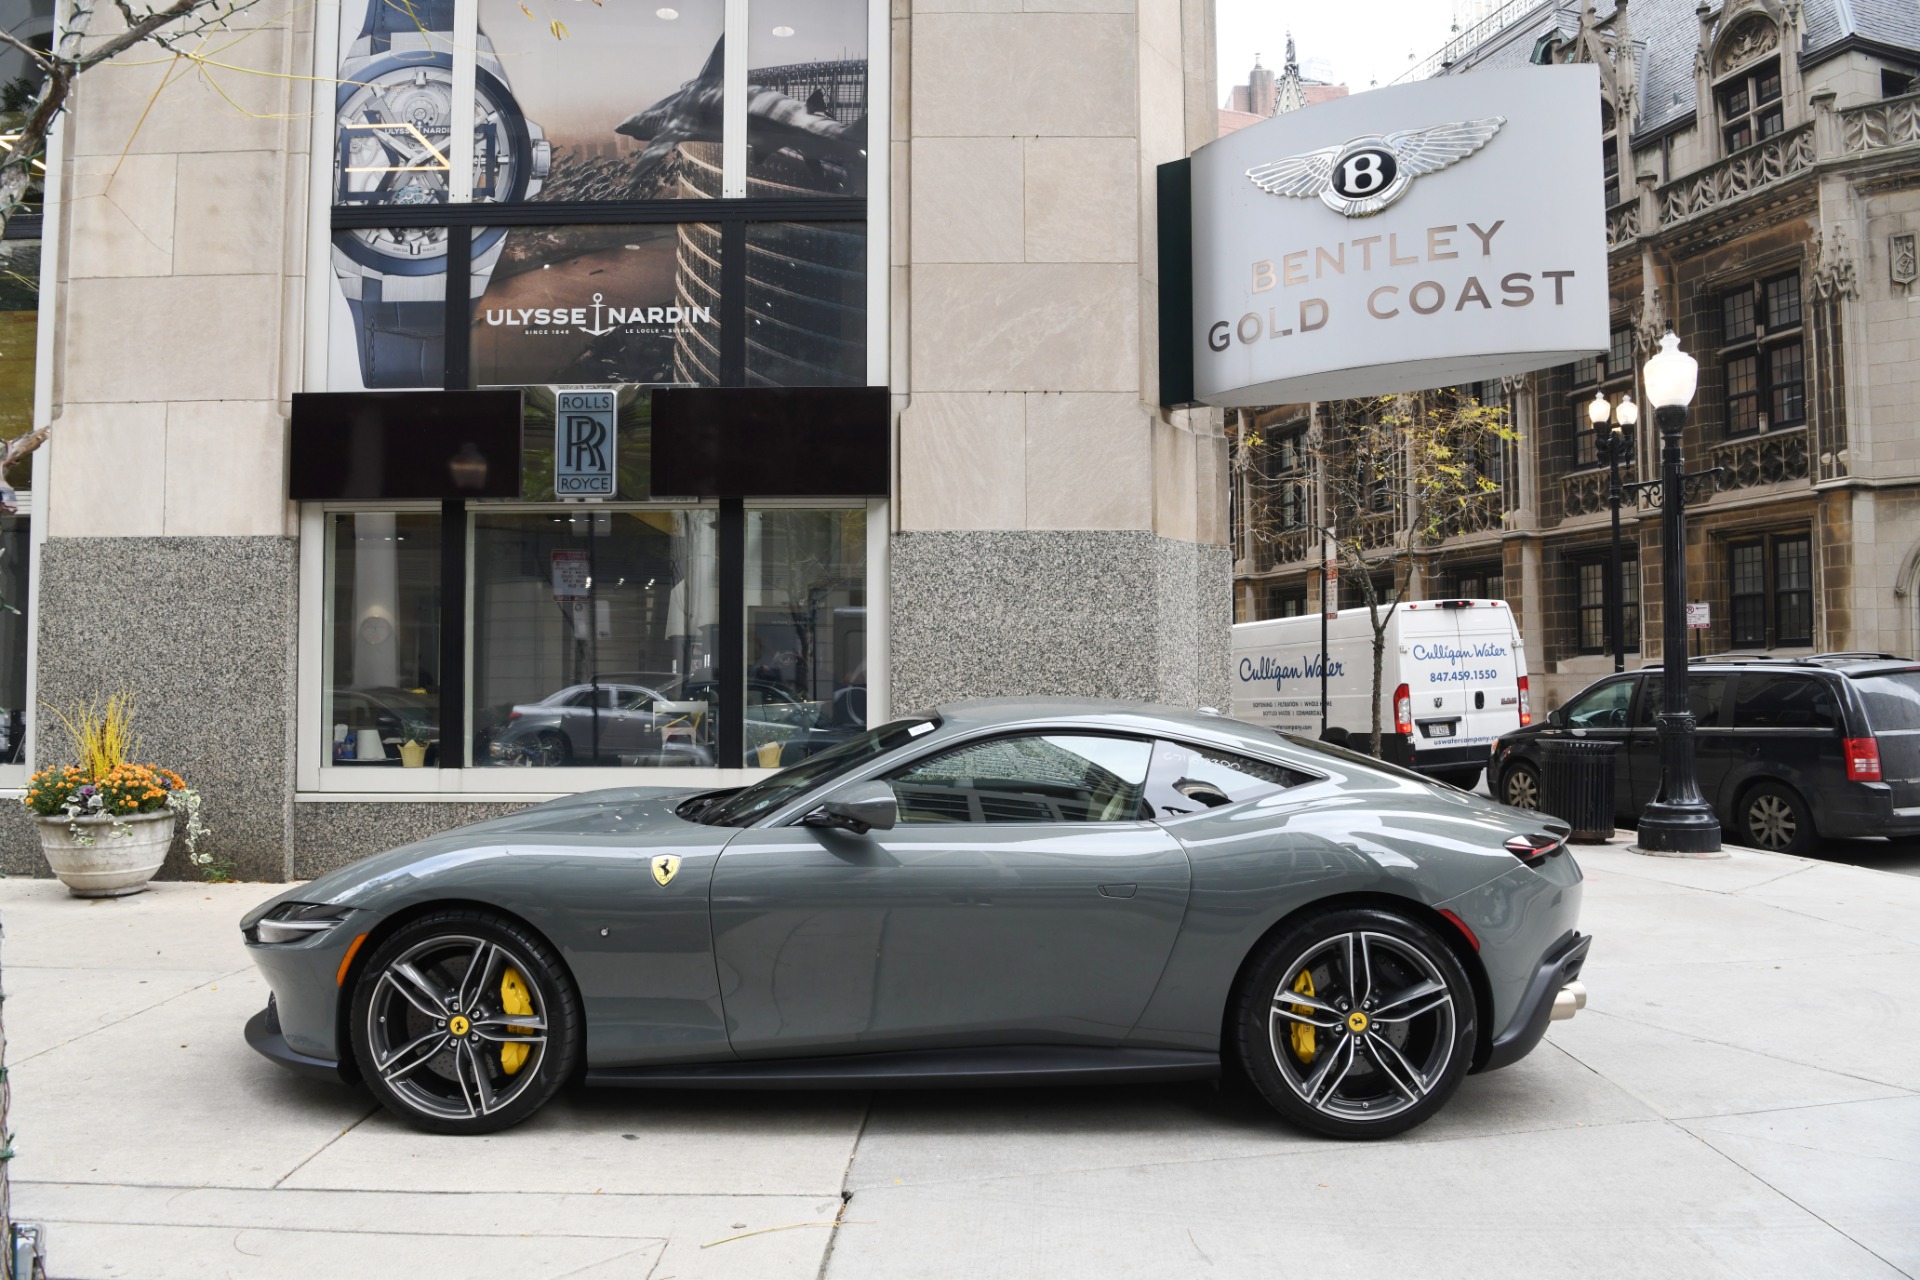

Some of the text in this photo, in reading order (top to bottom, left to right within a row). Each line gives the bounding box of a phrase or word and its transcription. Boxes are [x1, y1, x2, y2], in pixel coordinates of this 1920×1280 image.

[384, 127, 413, 135] ULYSS
[1342, 152, 1384, 194] B
[1251, 219, 1505, 294] BENTLEY
[486, 306, 710, 326] ULYSSE NARDIN
[1208, 270, 1575, 352] GOLD COAST
[562, 396, 610, 409] ROLLS
[565, 415, 607, 472] RR
[561, 477, 609, 490] ROYCE
[1413, 642, 1508, 666] Culligan Water
[1239, 656, 1302, 692] Culligan
[1430, 669, 1497, 683] 847.459.1550
[1433, 735, 1499, 746] uswatercompany.co
